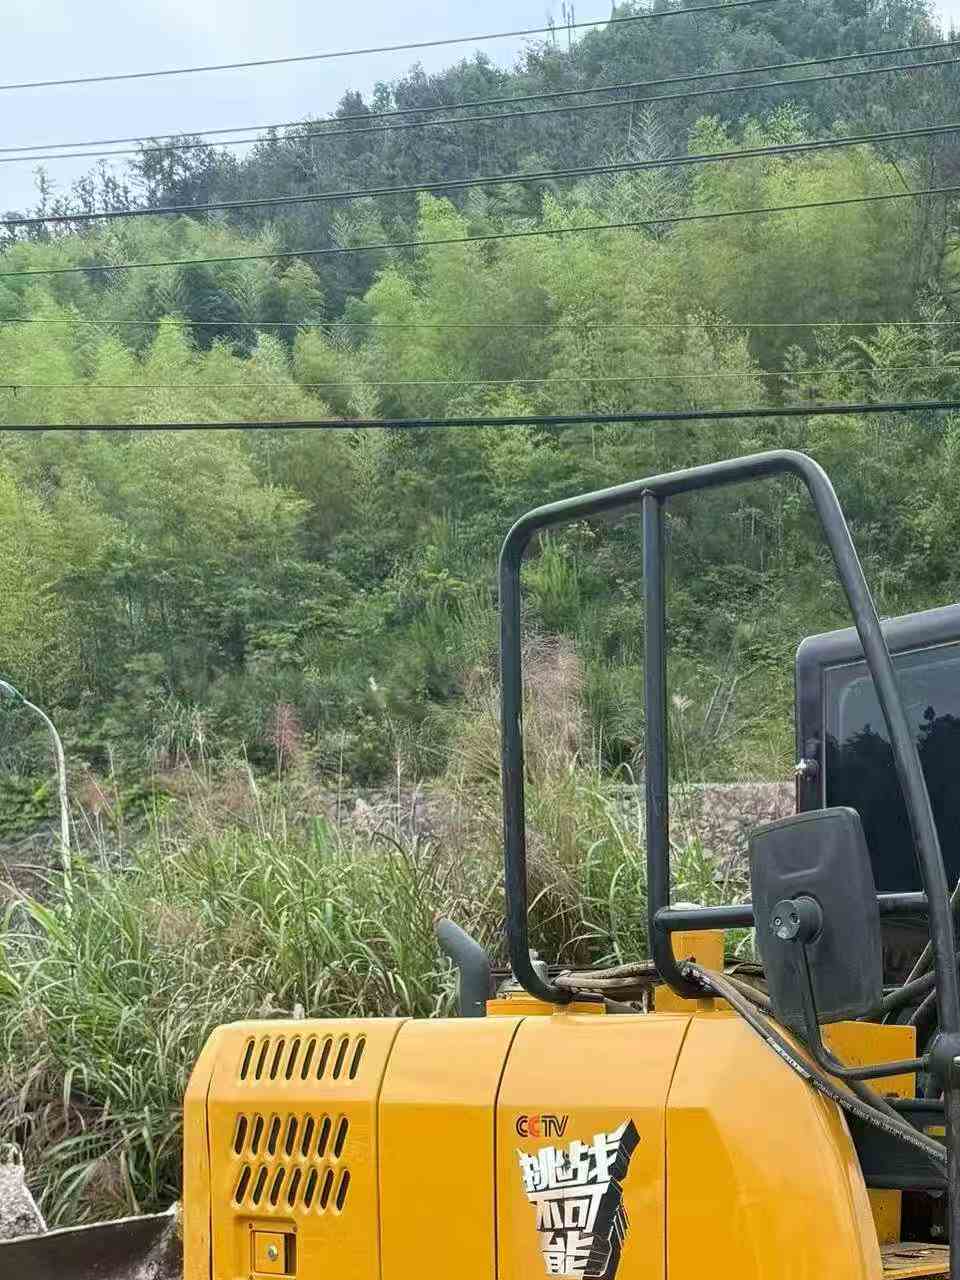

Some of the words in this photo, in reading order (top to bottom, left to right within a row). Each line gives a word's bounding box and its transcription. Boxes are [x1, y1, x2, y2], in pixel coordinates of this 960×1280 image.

[516, 1115, 568, 1138] CCTV
[517, 1119, 633, 1193] 挑战
[526, 1182, 611, 1233] 不可
[541, 1230, 595, 1280] 能
